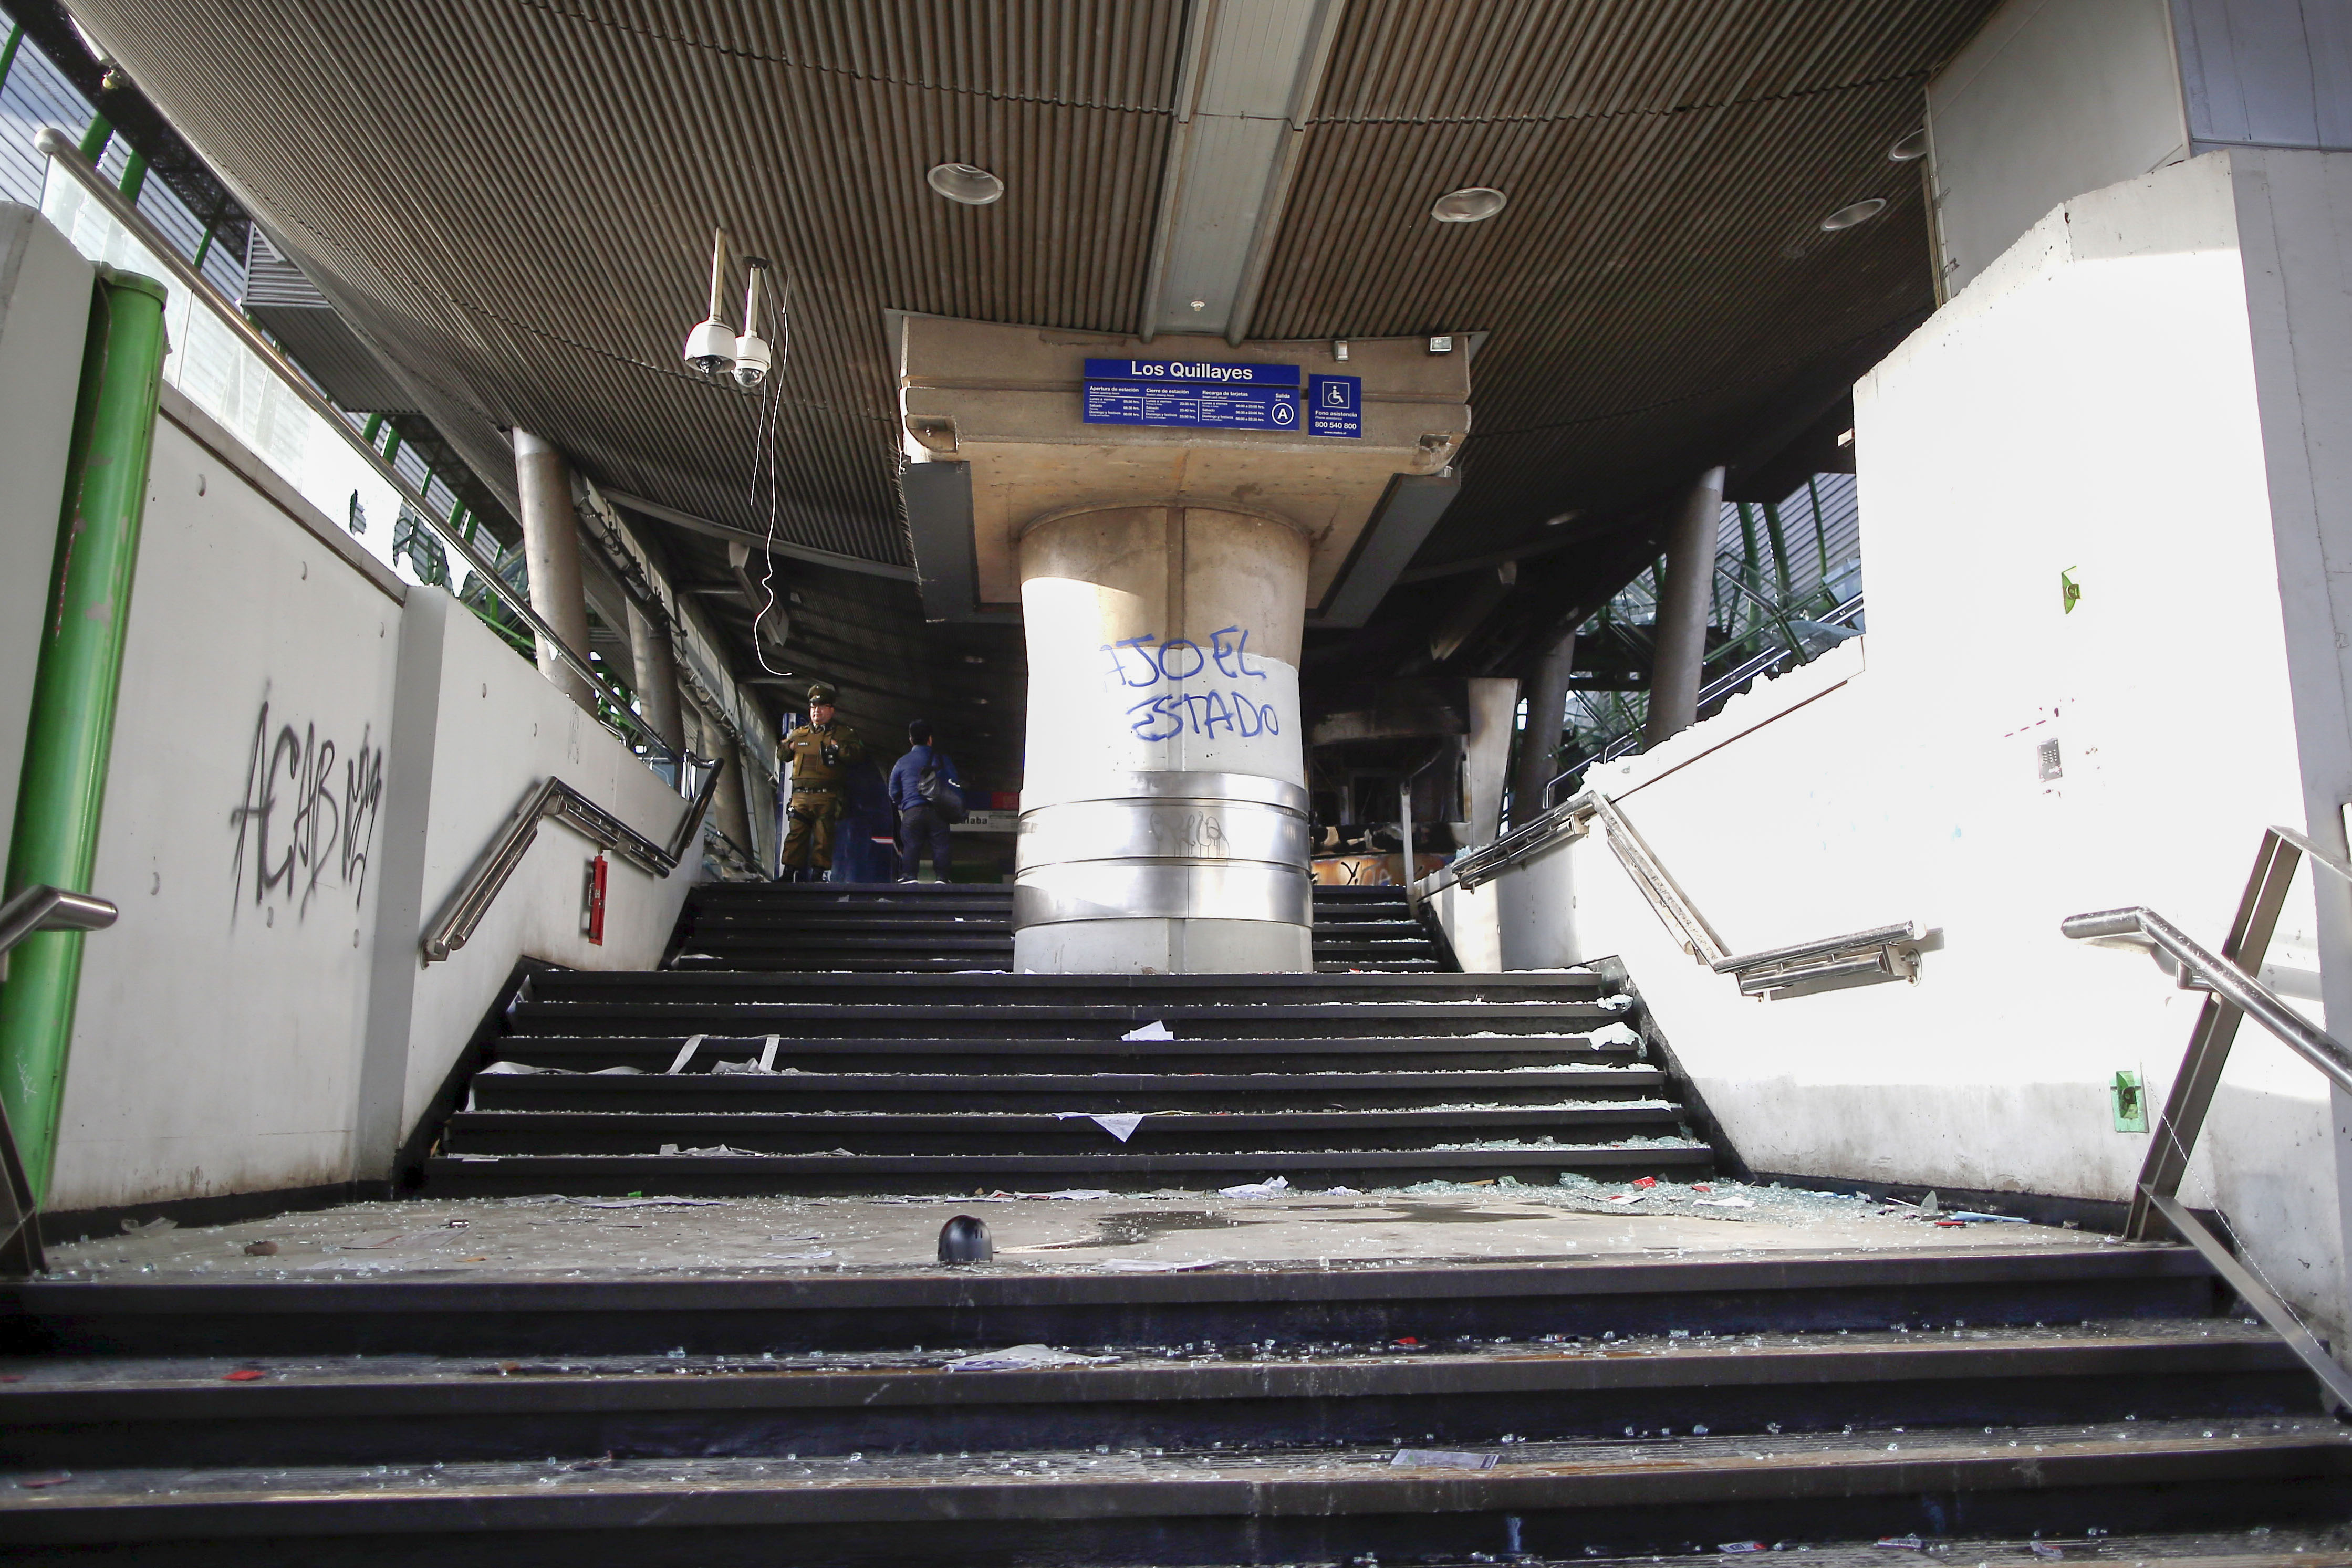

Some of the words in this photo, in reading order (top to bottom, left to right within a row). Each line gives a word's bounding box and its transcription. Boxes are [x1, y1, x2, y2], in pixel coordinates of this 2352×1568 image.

[1131, 361, 1164, 375] Los
[1170, 362, 1253, 382] Quillayes
[1277, 408, 1288, 419] A
[1126, 688, 1278, 741] ESTADO
[230, 696, 339, 931] ACAB
